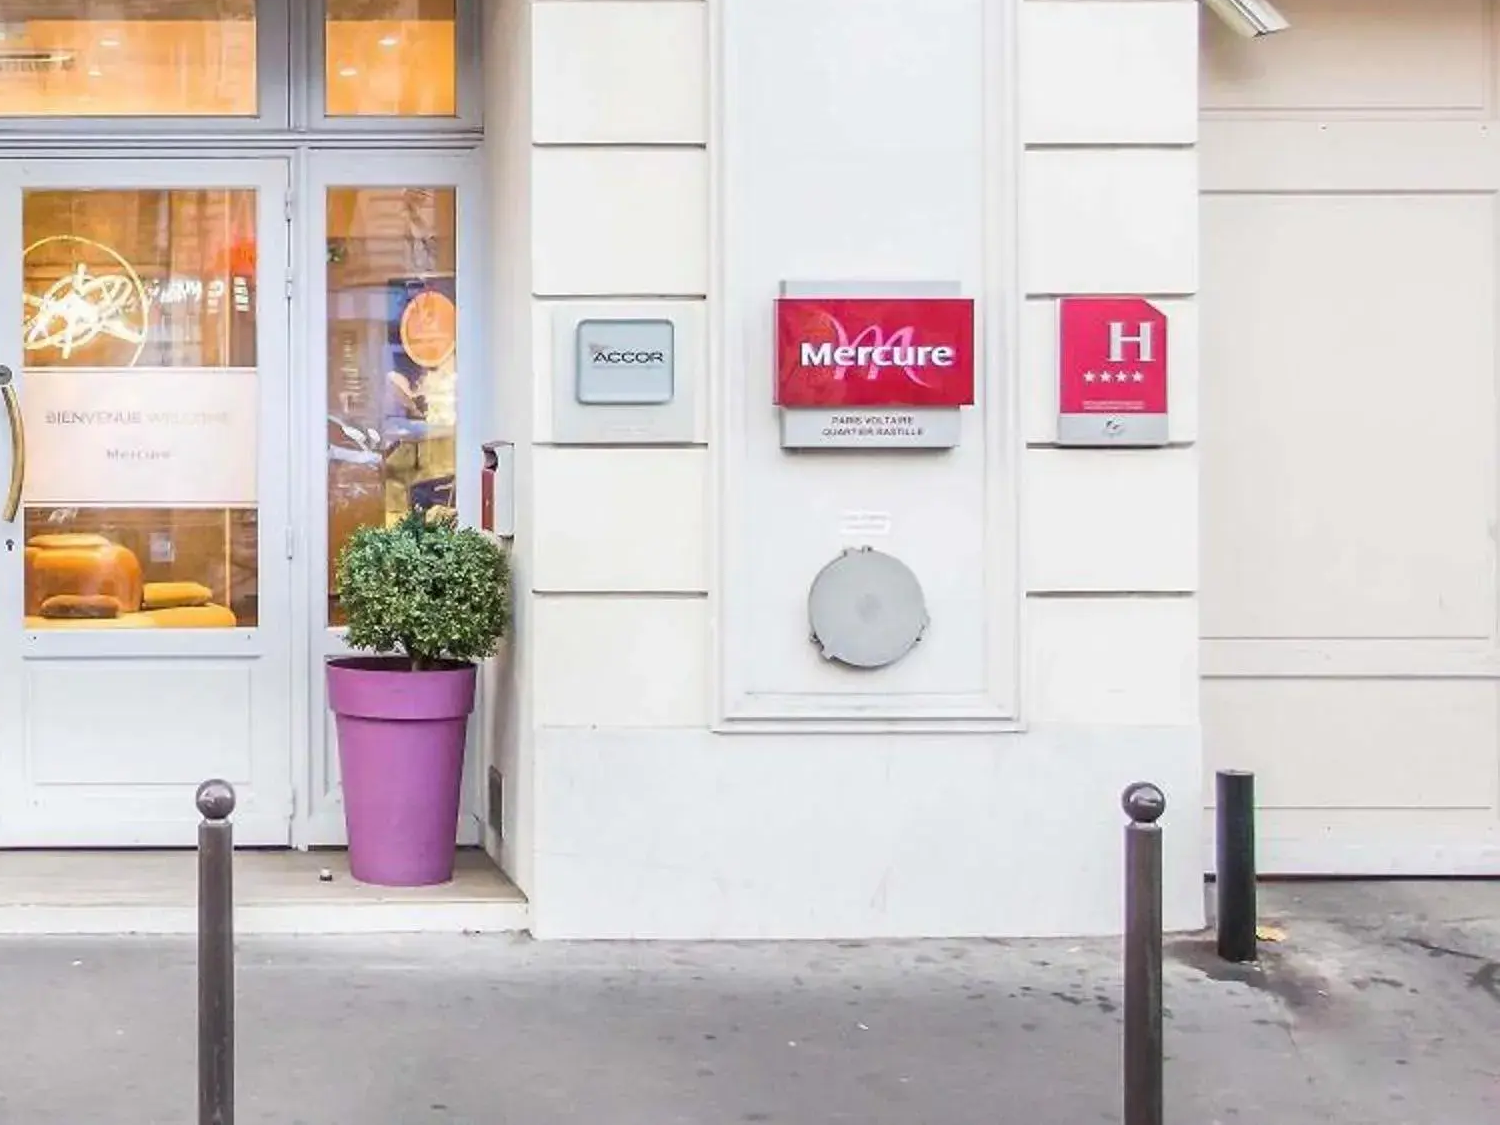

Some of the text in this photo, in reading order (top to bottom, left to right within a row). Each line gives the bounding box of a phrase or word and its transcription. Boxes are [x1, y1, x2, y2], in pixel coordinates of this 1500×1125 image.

[1106, 321, 1156, 363] H
[593, 351, 664, 364] ACCOR
[800, 341, 955, 367] Mercure
[45, 410, 142, 425] BIENVENUE
[831, 416, 914, 425] PARIS VOLTAIRE
[821, 427, 924, 437] QUARTIER BASTILLE
